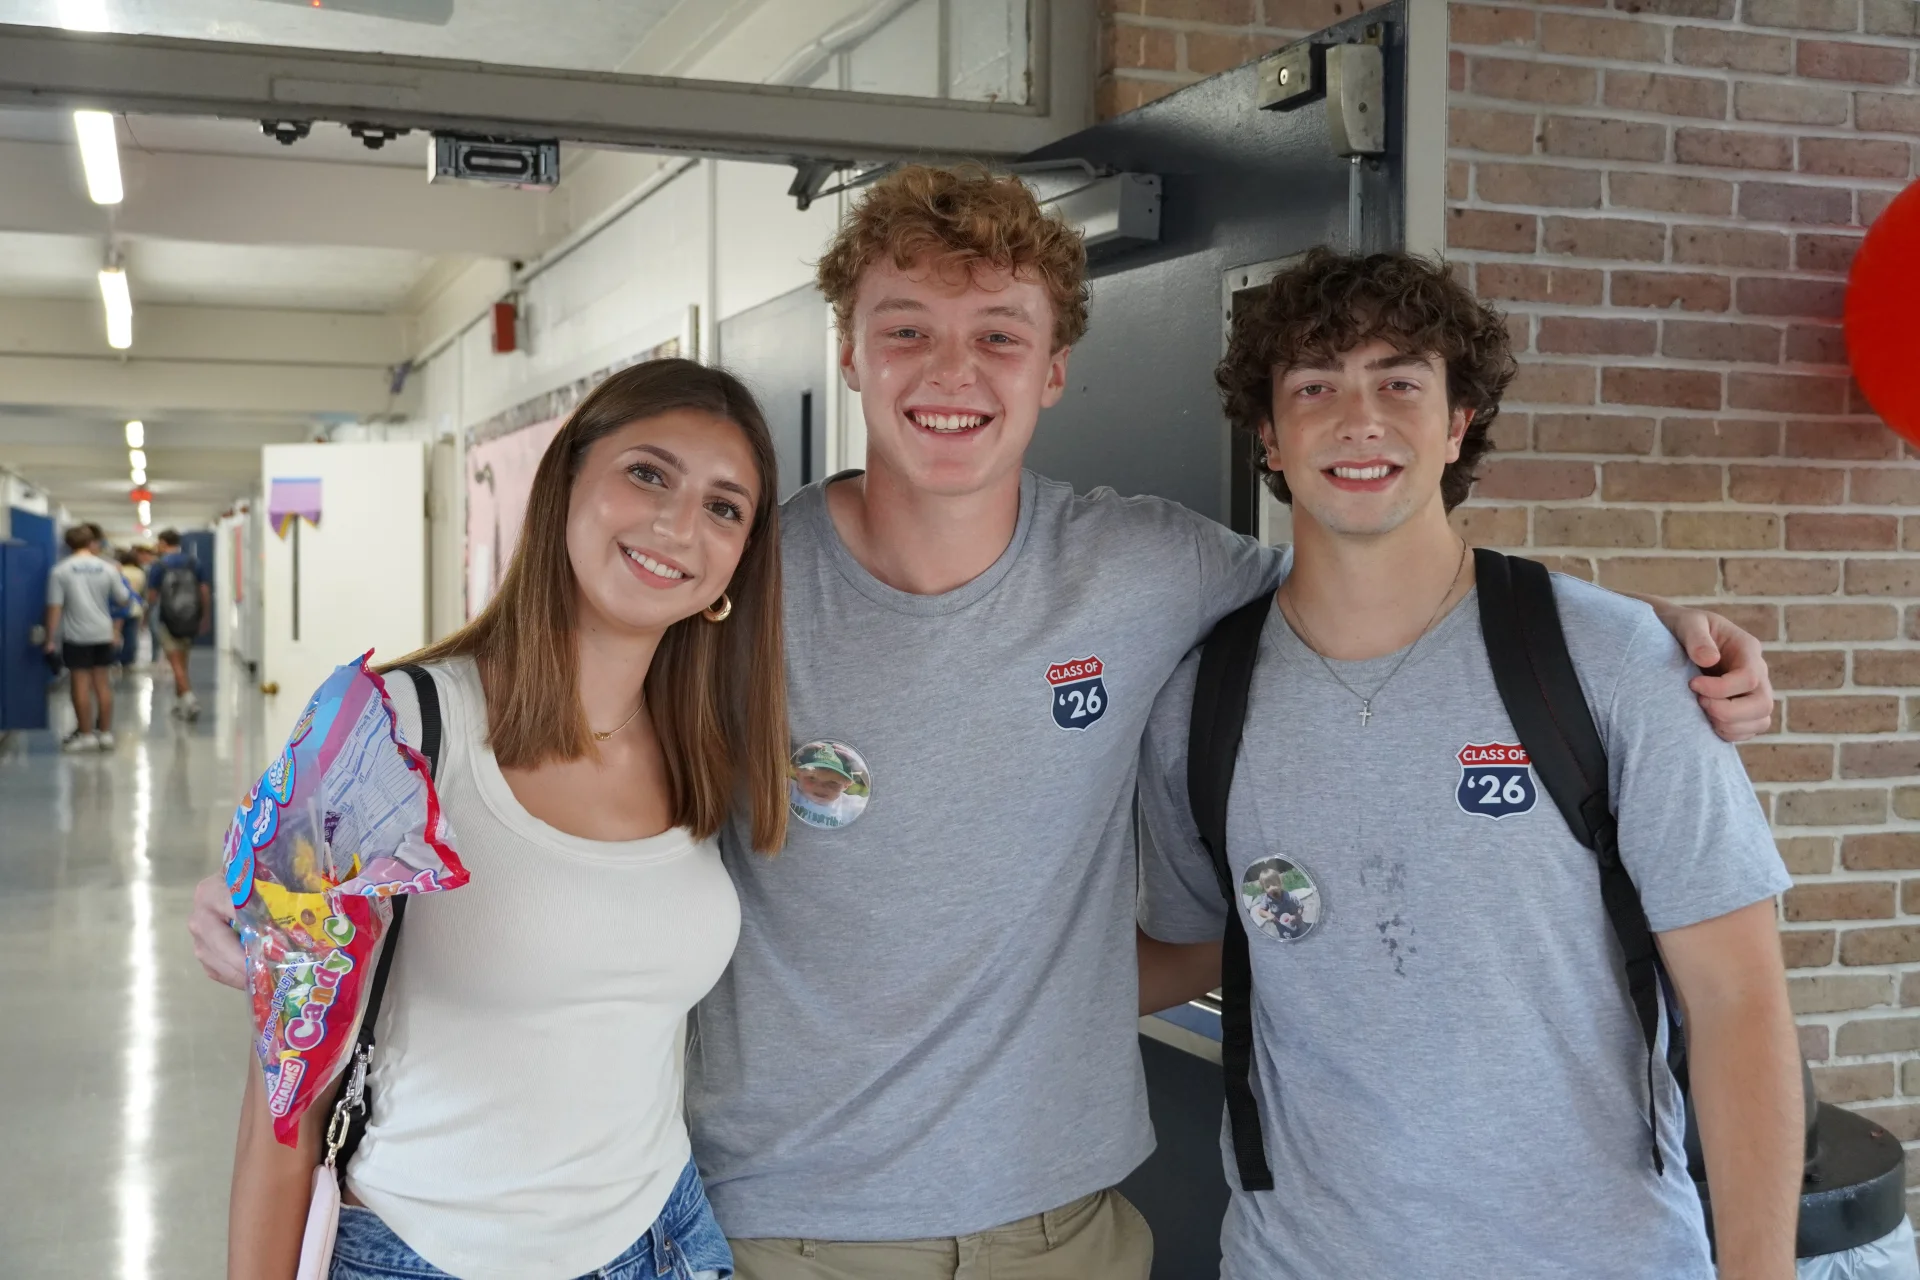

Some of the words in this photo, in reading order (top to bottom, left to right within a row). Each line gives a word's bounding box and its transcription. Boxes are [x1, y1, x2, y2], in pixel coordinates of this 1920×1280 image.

[1049, 664, 1083, 680] CLASS
[1084, 661, 1099, 673] OF
[1058, 686, 1102, 719] '26
[1462, 749, 1506, 761] CLASS
[1507, 749, 1527, 761] OF
[1467, 774, 1526, 804] '26
[252, 796, 273, 845] POPS
[285, 949, 354, 1050] Candy
[263, 1027, 275, 1042] WT
[270, 1062, 301, 1114] CHARMS
